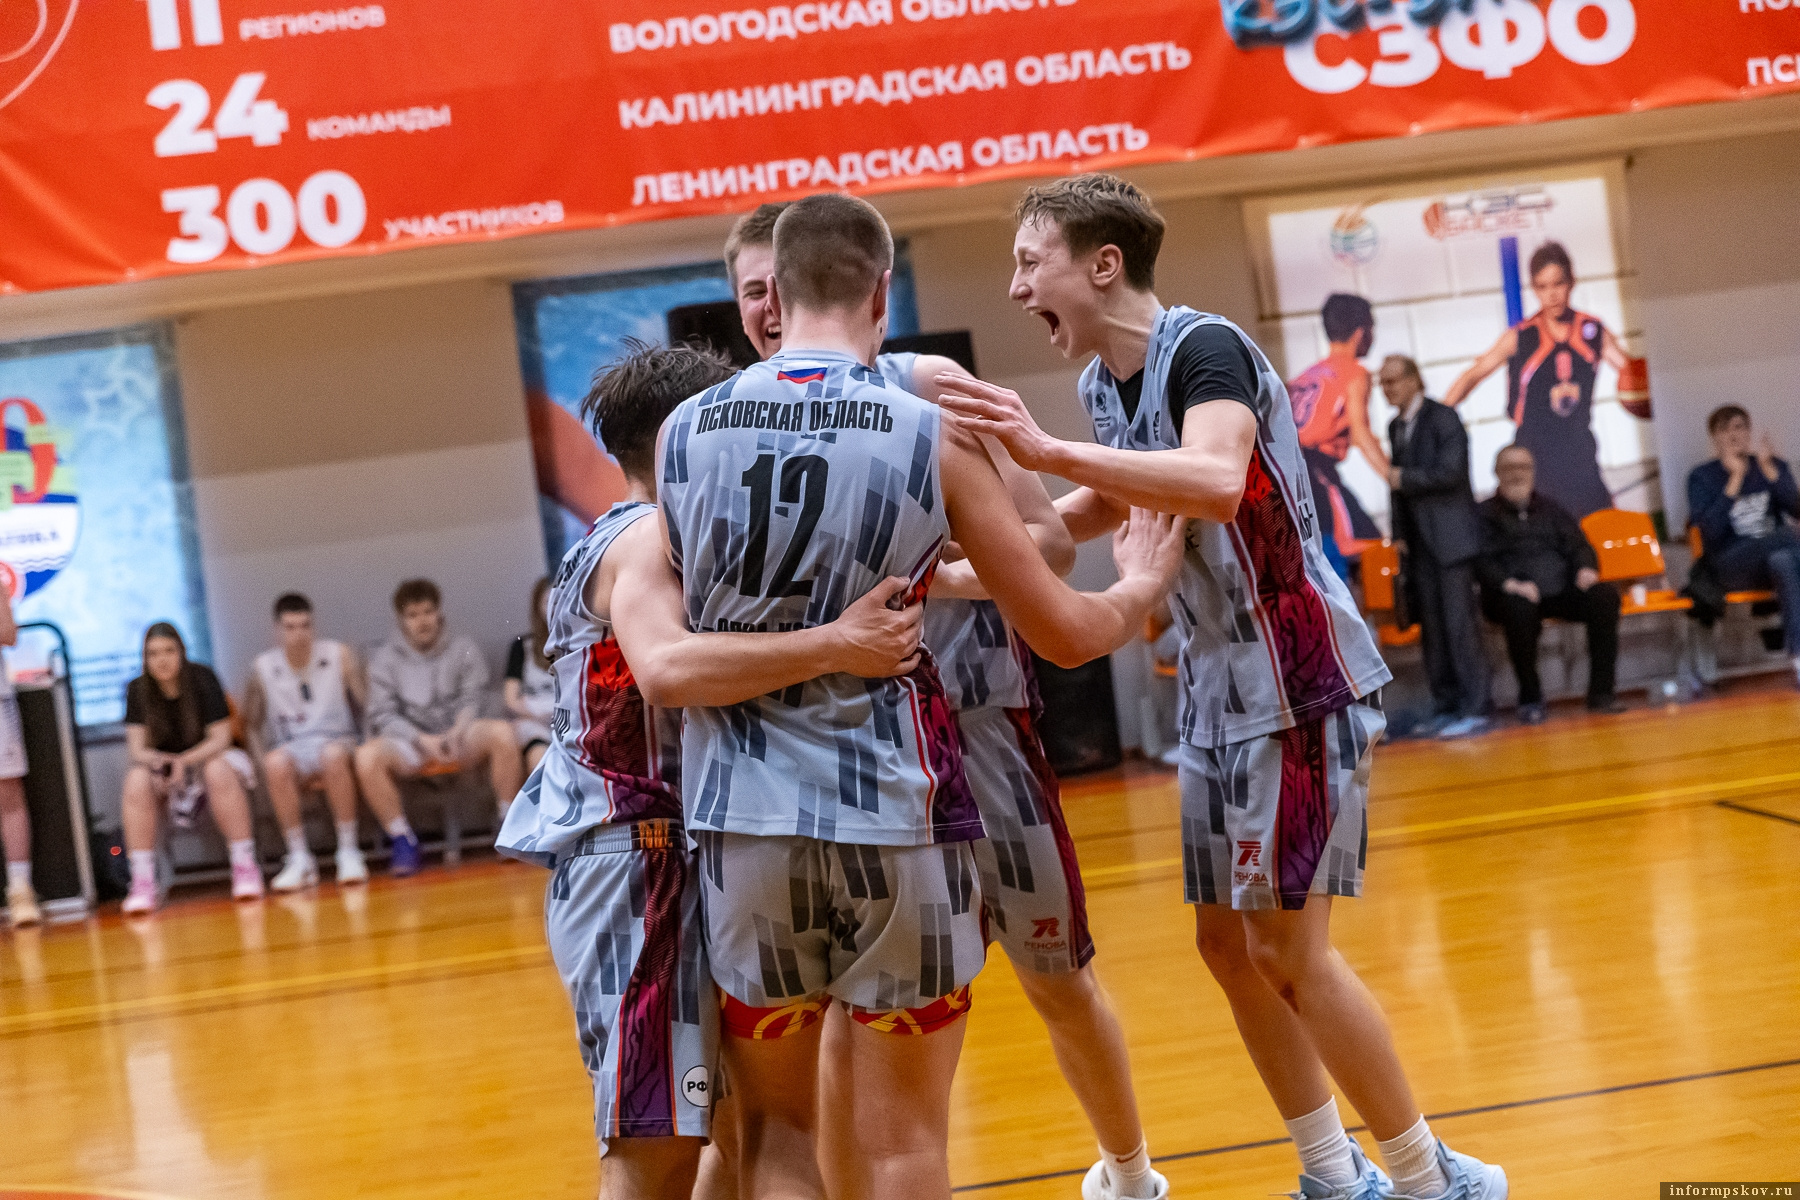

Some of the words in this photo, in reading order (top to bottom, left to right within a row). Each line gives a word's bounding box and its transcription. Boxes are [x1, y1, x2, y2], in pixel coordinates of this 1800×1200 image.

[146, 0, 224, 50] 11
[239, 5, 386, 41] РЕГИОНОВ
[609, 0, 893, 53] ВОЛОГОДСКАЯ
[1284, 0, 1636, 94] СЗФО
[146, 72, 289, 157] 24
[618, 60, 1008, 130] КАЛИНИНГРАДСКАЯ
[1014, 41, 1192, 86] ОБЛАСТЬ
[306, 105, 452, 141] КОМАНДЫ
[632, 142, 965, 206] ЛЕНИНГРАДСКАЯ
[971, 122, 1150, 168] ОБЛАСТЬ
[161, 170, 367, 264] 300
[384, 200, 565, 241] УЧАСТНИКОВ
[696, 400, 803, 435] ПСКОВСКАЯ
[809, 400, 894, 434] ОБЛАСТЬ
[740, 453, 829, 599] 12
